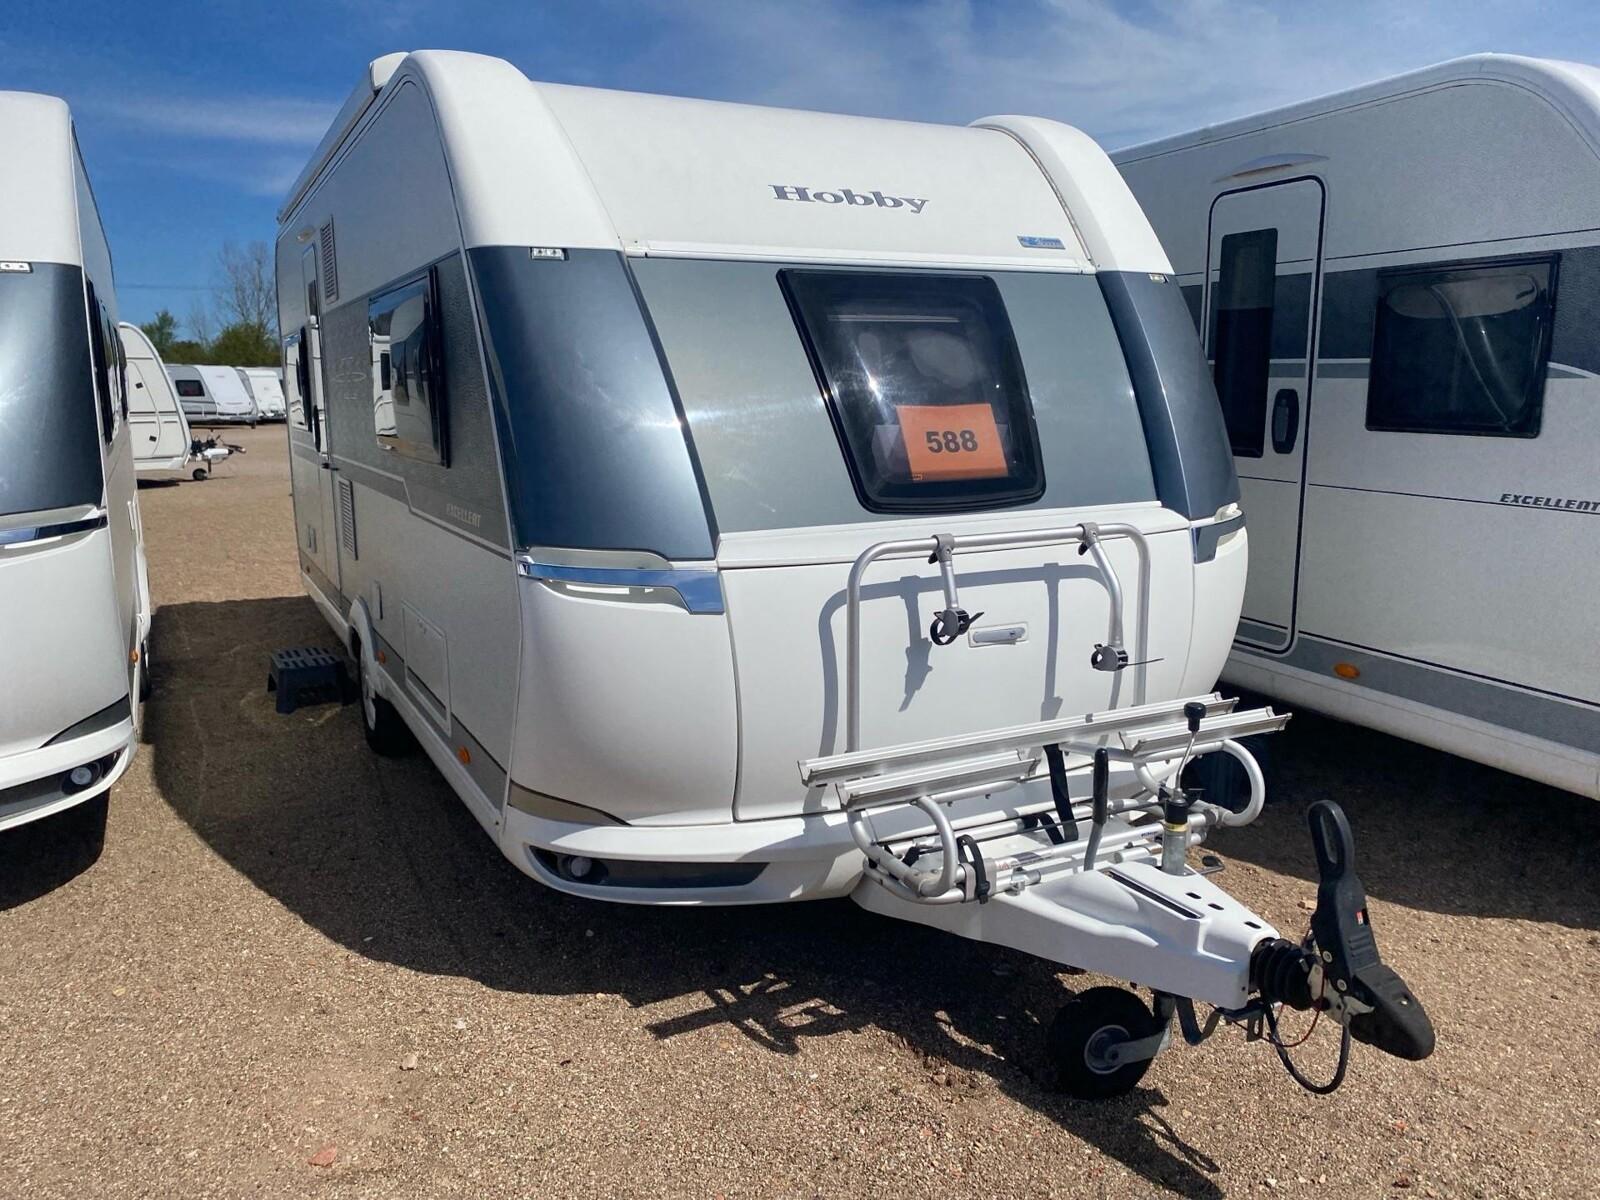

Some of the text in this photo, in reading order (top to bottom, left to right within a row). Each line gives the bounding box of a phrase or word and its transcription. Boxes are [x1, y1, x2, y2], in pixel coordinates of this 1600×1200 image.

[768, 184, 930, 214] Hobby
[926, 430, 978, 453] 588
[1500, 493, 1600, 511] EXCELLENT
